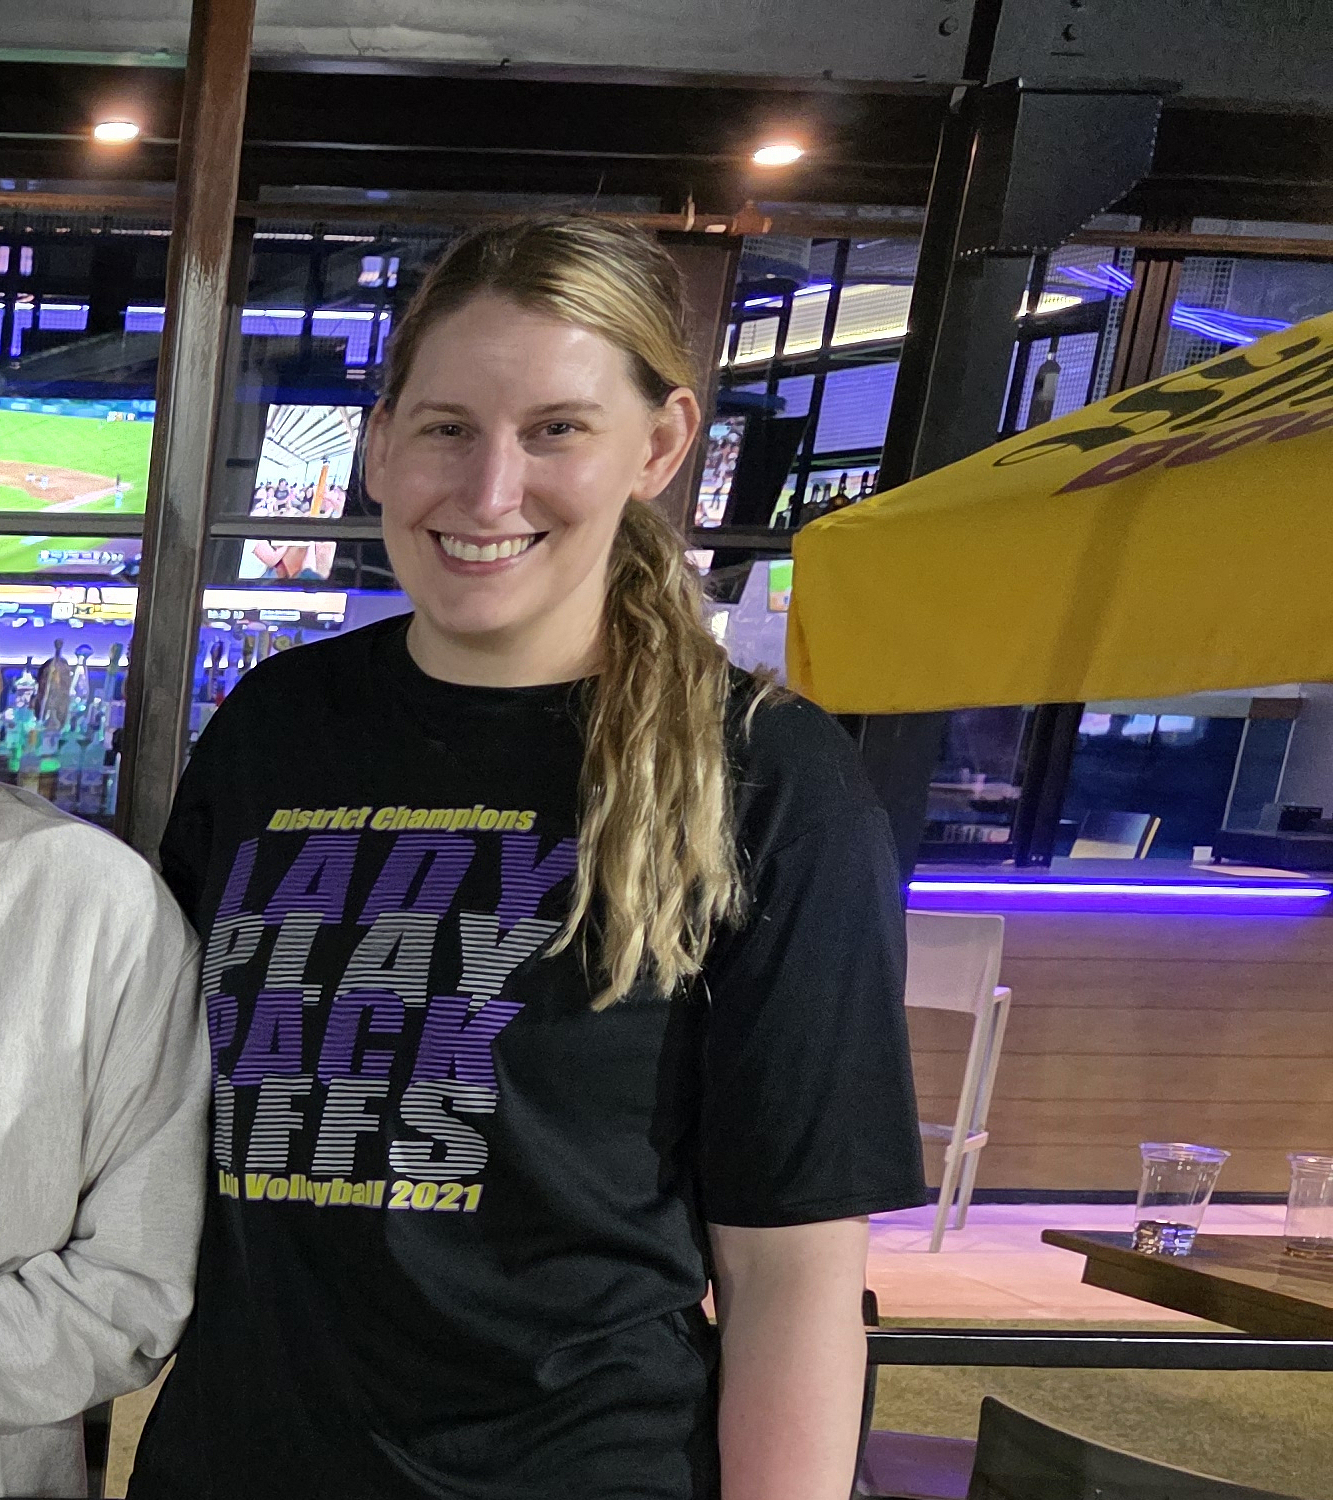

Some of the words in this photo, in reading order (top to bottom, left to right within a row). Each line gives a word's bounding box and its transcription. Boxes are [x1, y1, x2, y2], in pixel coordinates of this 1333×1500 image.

[266, 806, 373, 832] District
[369, 804, 537, 833] Champions
[202, 911, 564, 1011] PLAY
[387, 1180, 484, 1213] 2021
